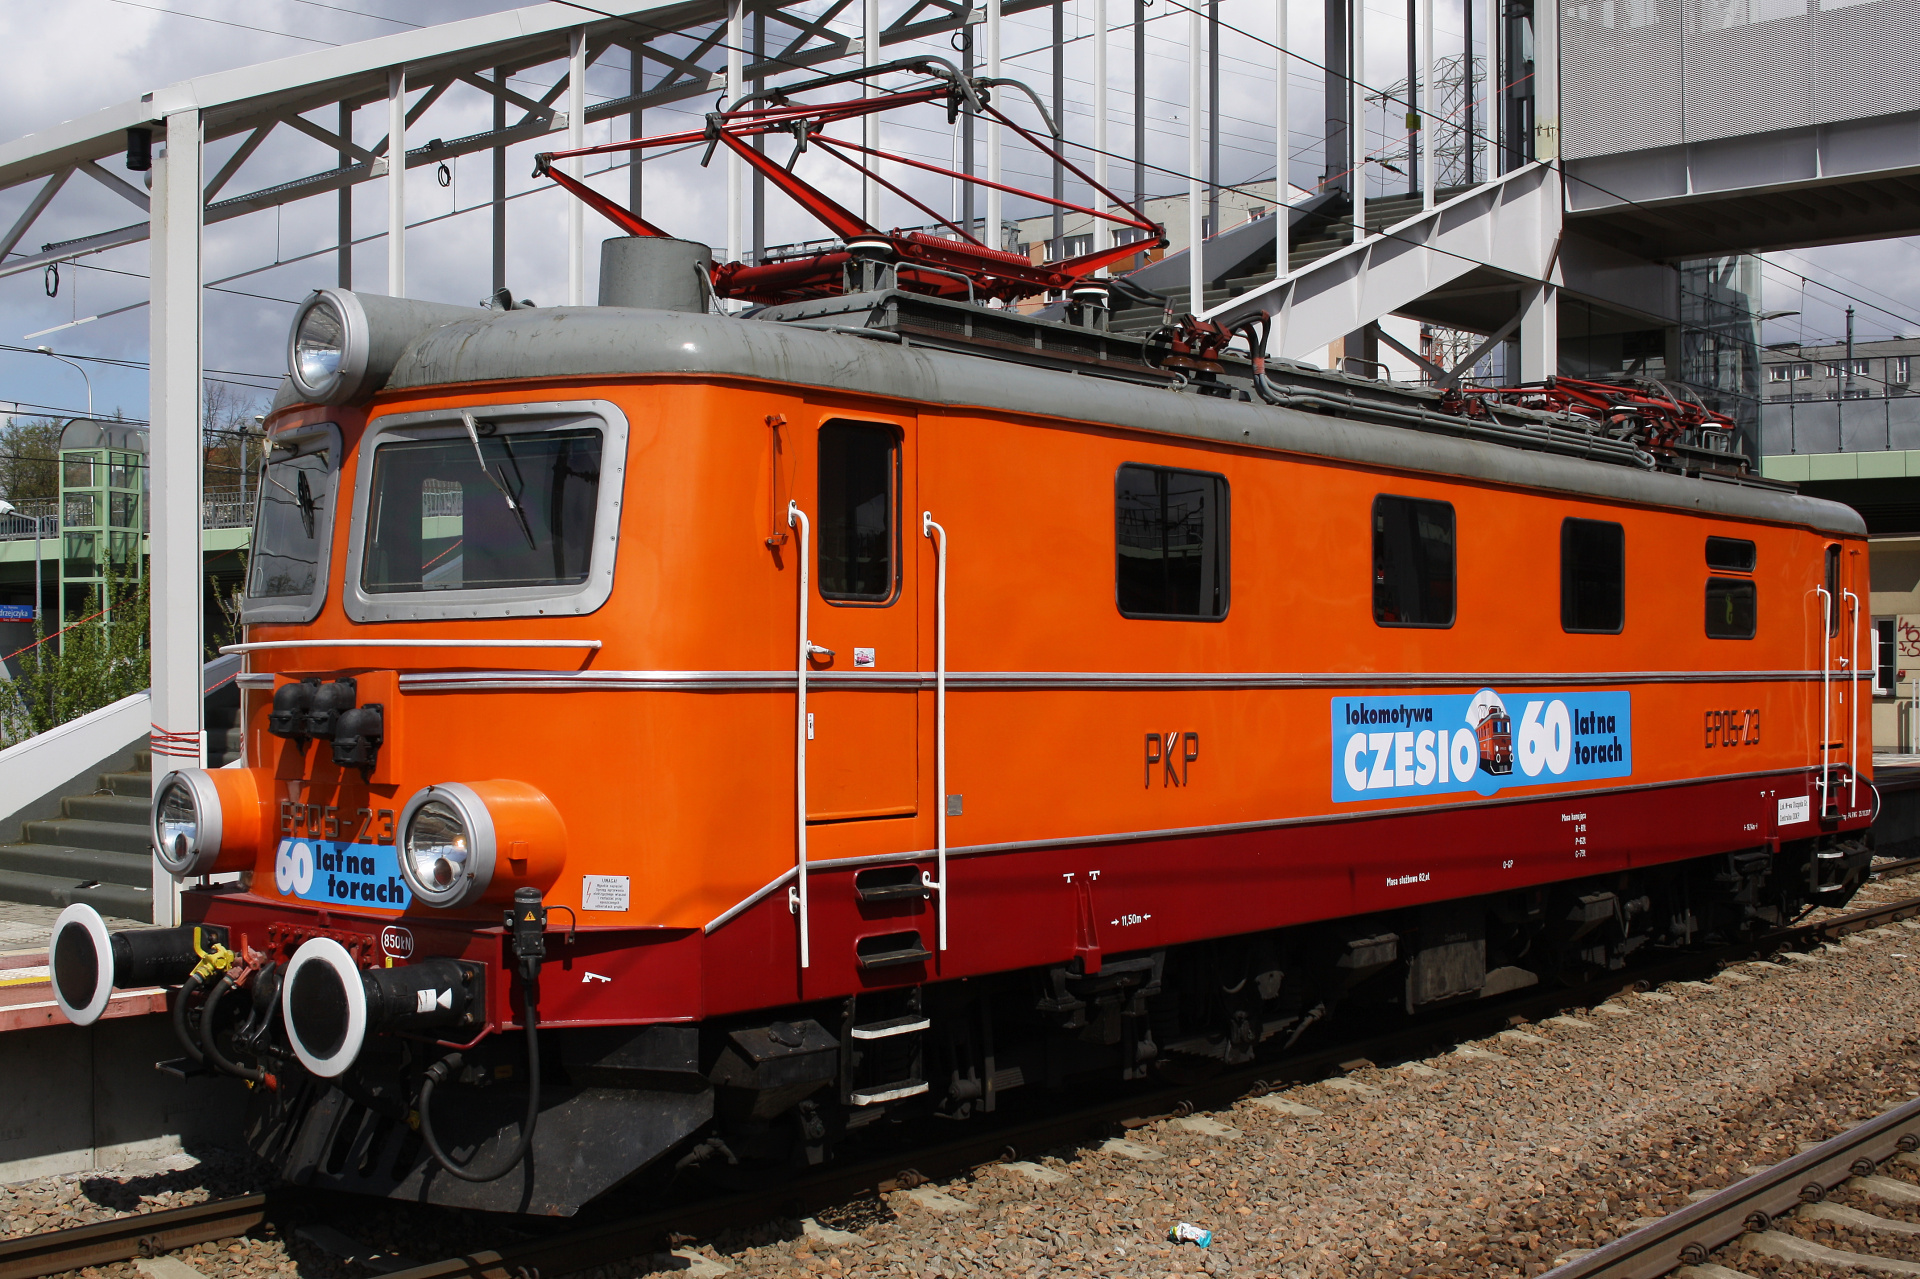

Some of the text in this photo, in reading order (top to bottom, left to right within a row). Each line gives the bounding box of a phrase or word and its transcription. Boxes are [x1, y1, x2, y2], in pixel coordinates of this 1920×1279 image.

[1345, 702, 1433, 728] lokomotywa
[1574, 709, 1616, 735] lat na
[1705, 709, 1760, 748] EP05-23
[1517, 699, 1571, 777] 60
[1575, 736, 1623, 765] torach
[1145, 731, 1199, 788] PKP
[1344, 728, 1478, 791] CZESIO
[280, 801, 394, 841] EP05-23
[276, 840, 314, 895] 60
[316, 844, 375, 875] lat na
[328, 874, 404, 903] torach
[1386, 877, 1398, 886] Masa
[1121, 914, 1142, 927] 11,50m
[384, 934, 411, 951] 850kN
